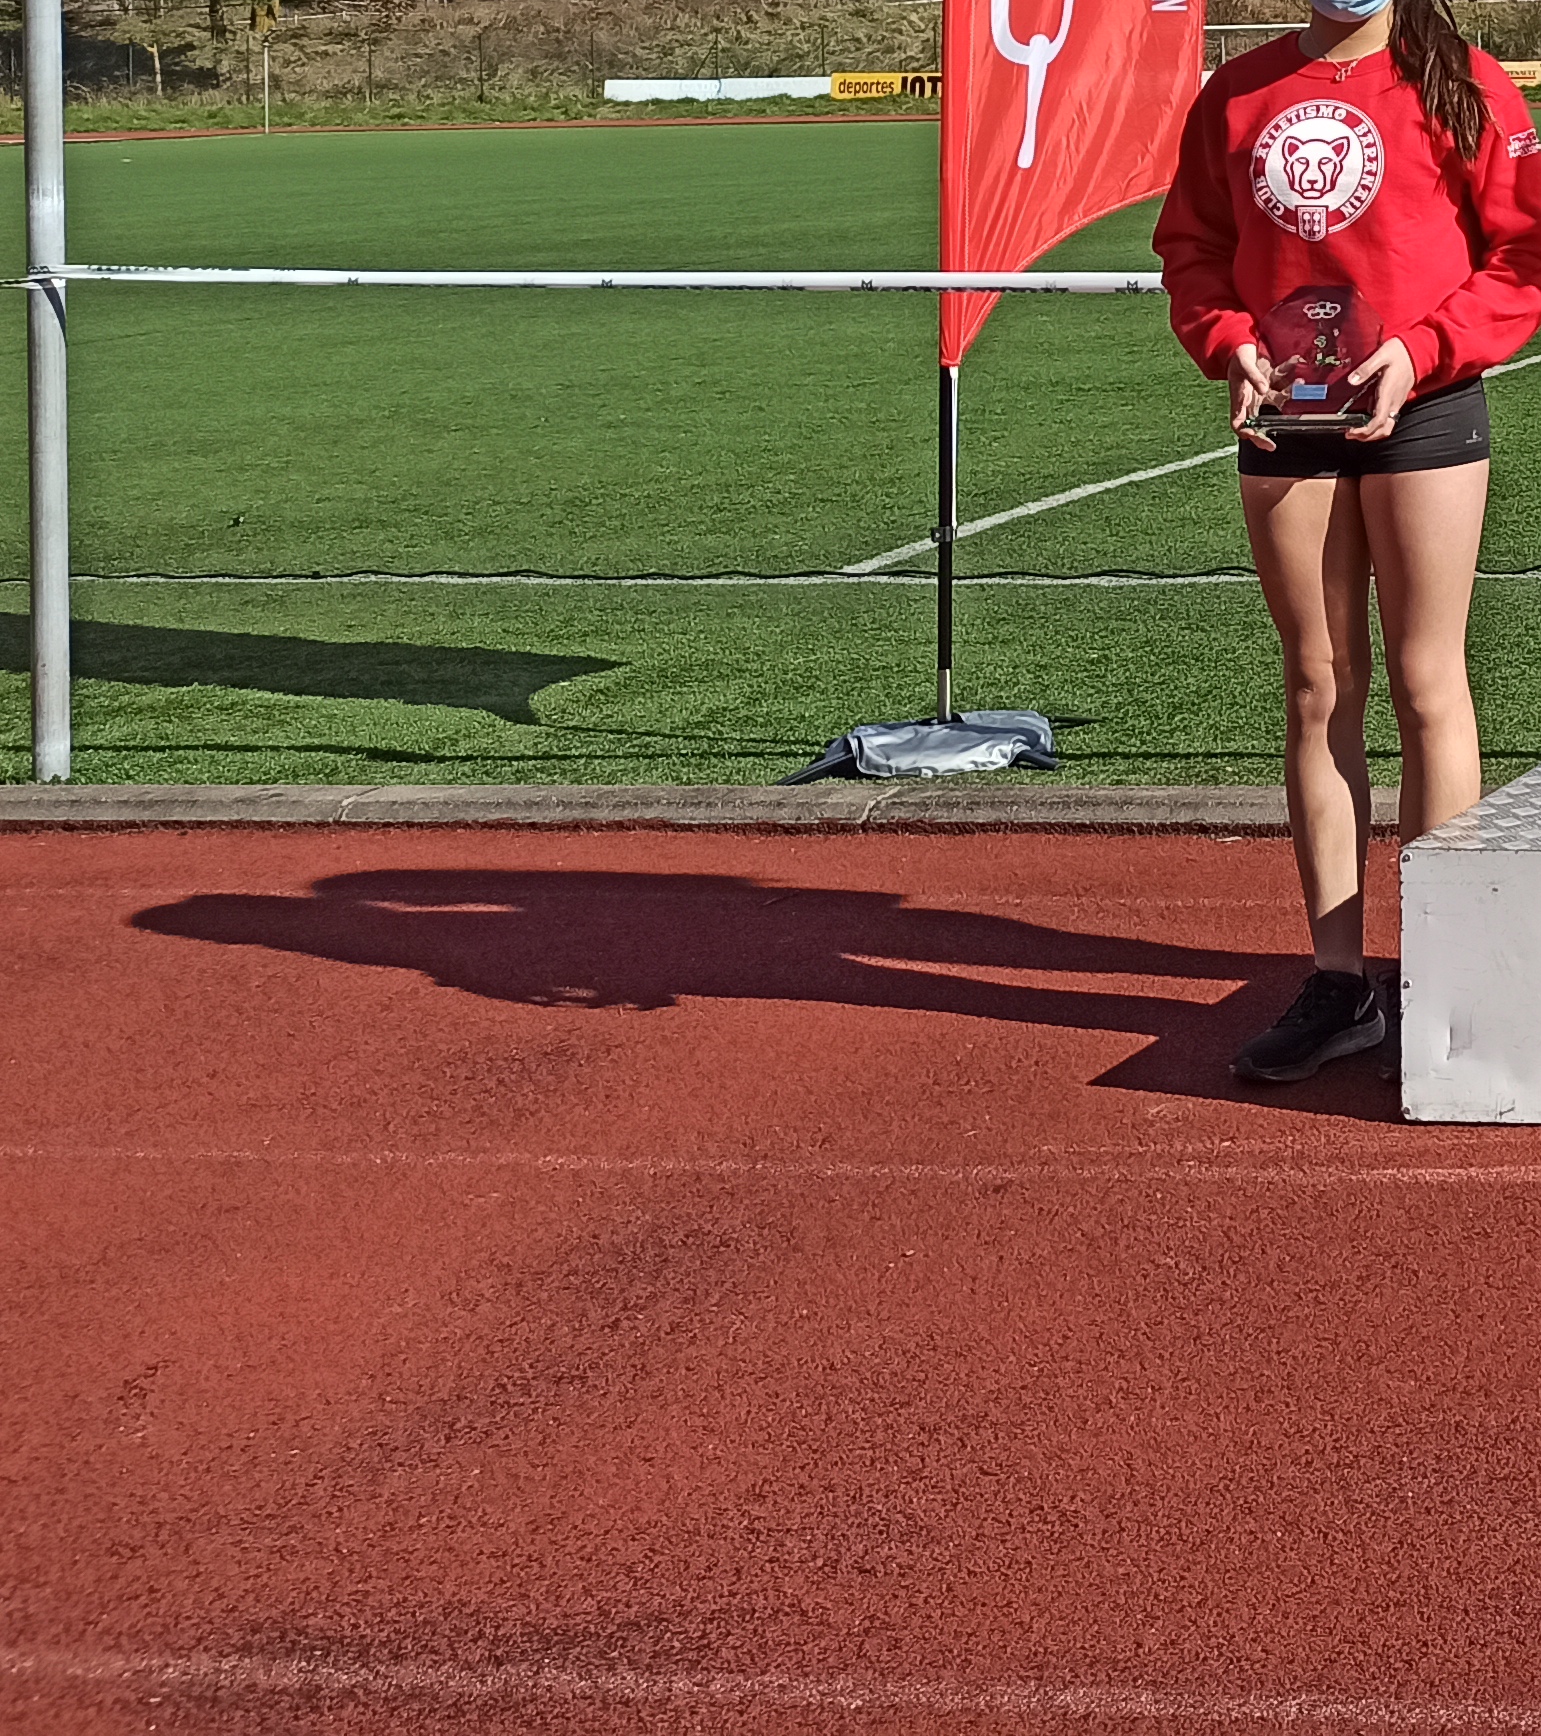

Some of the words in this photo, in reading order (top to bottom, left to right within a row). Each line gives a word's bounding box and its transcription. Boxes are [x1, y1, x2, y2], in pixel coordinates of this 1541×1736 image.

[838, 79, 895, 96] deportes
[1256, 105, 1347, 160] ATLETISMO
[1256, 175, 1285, 216] CLUB
